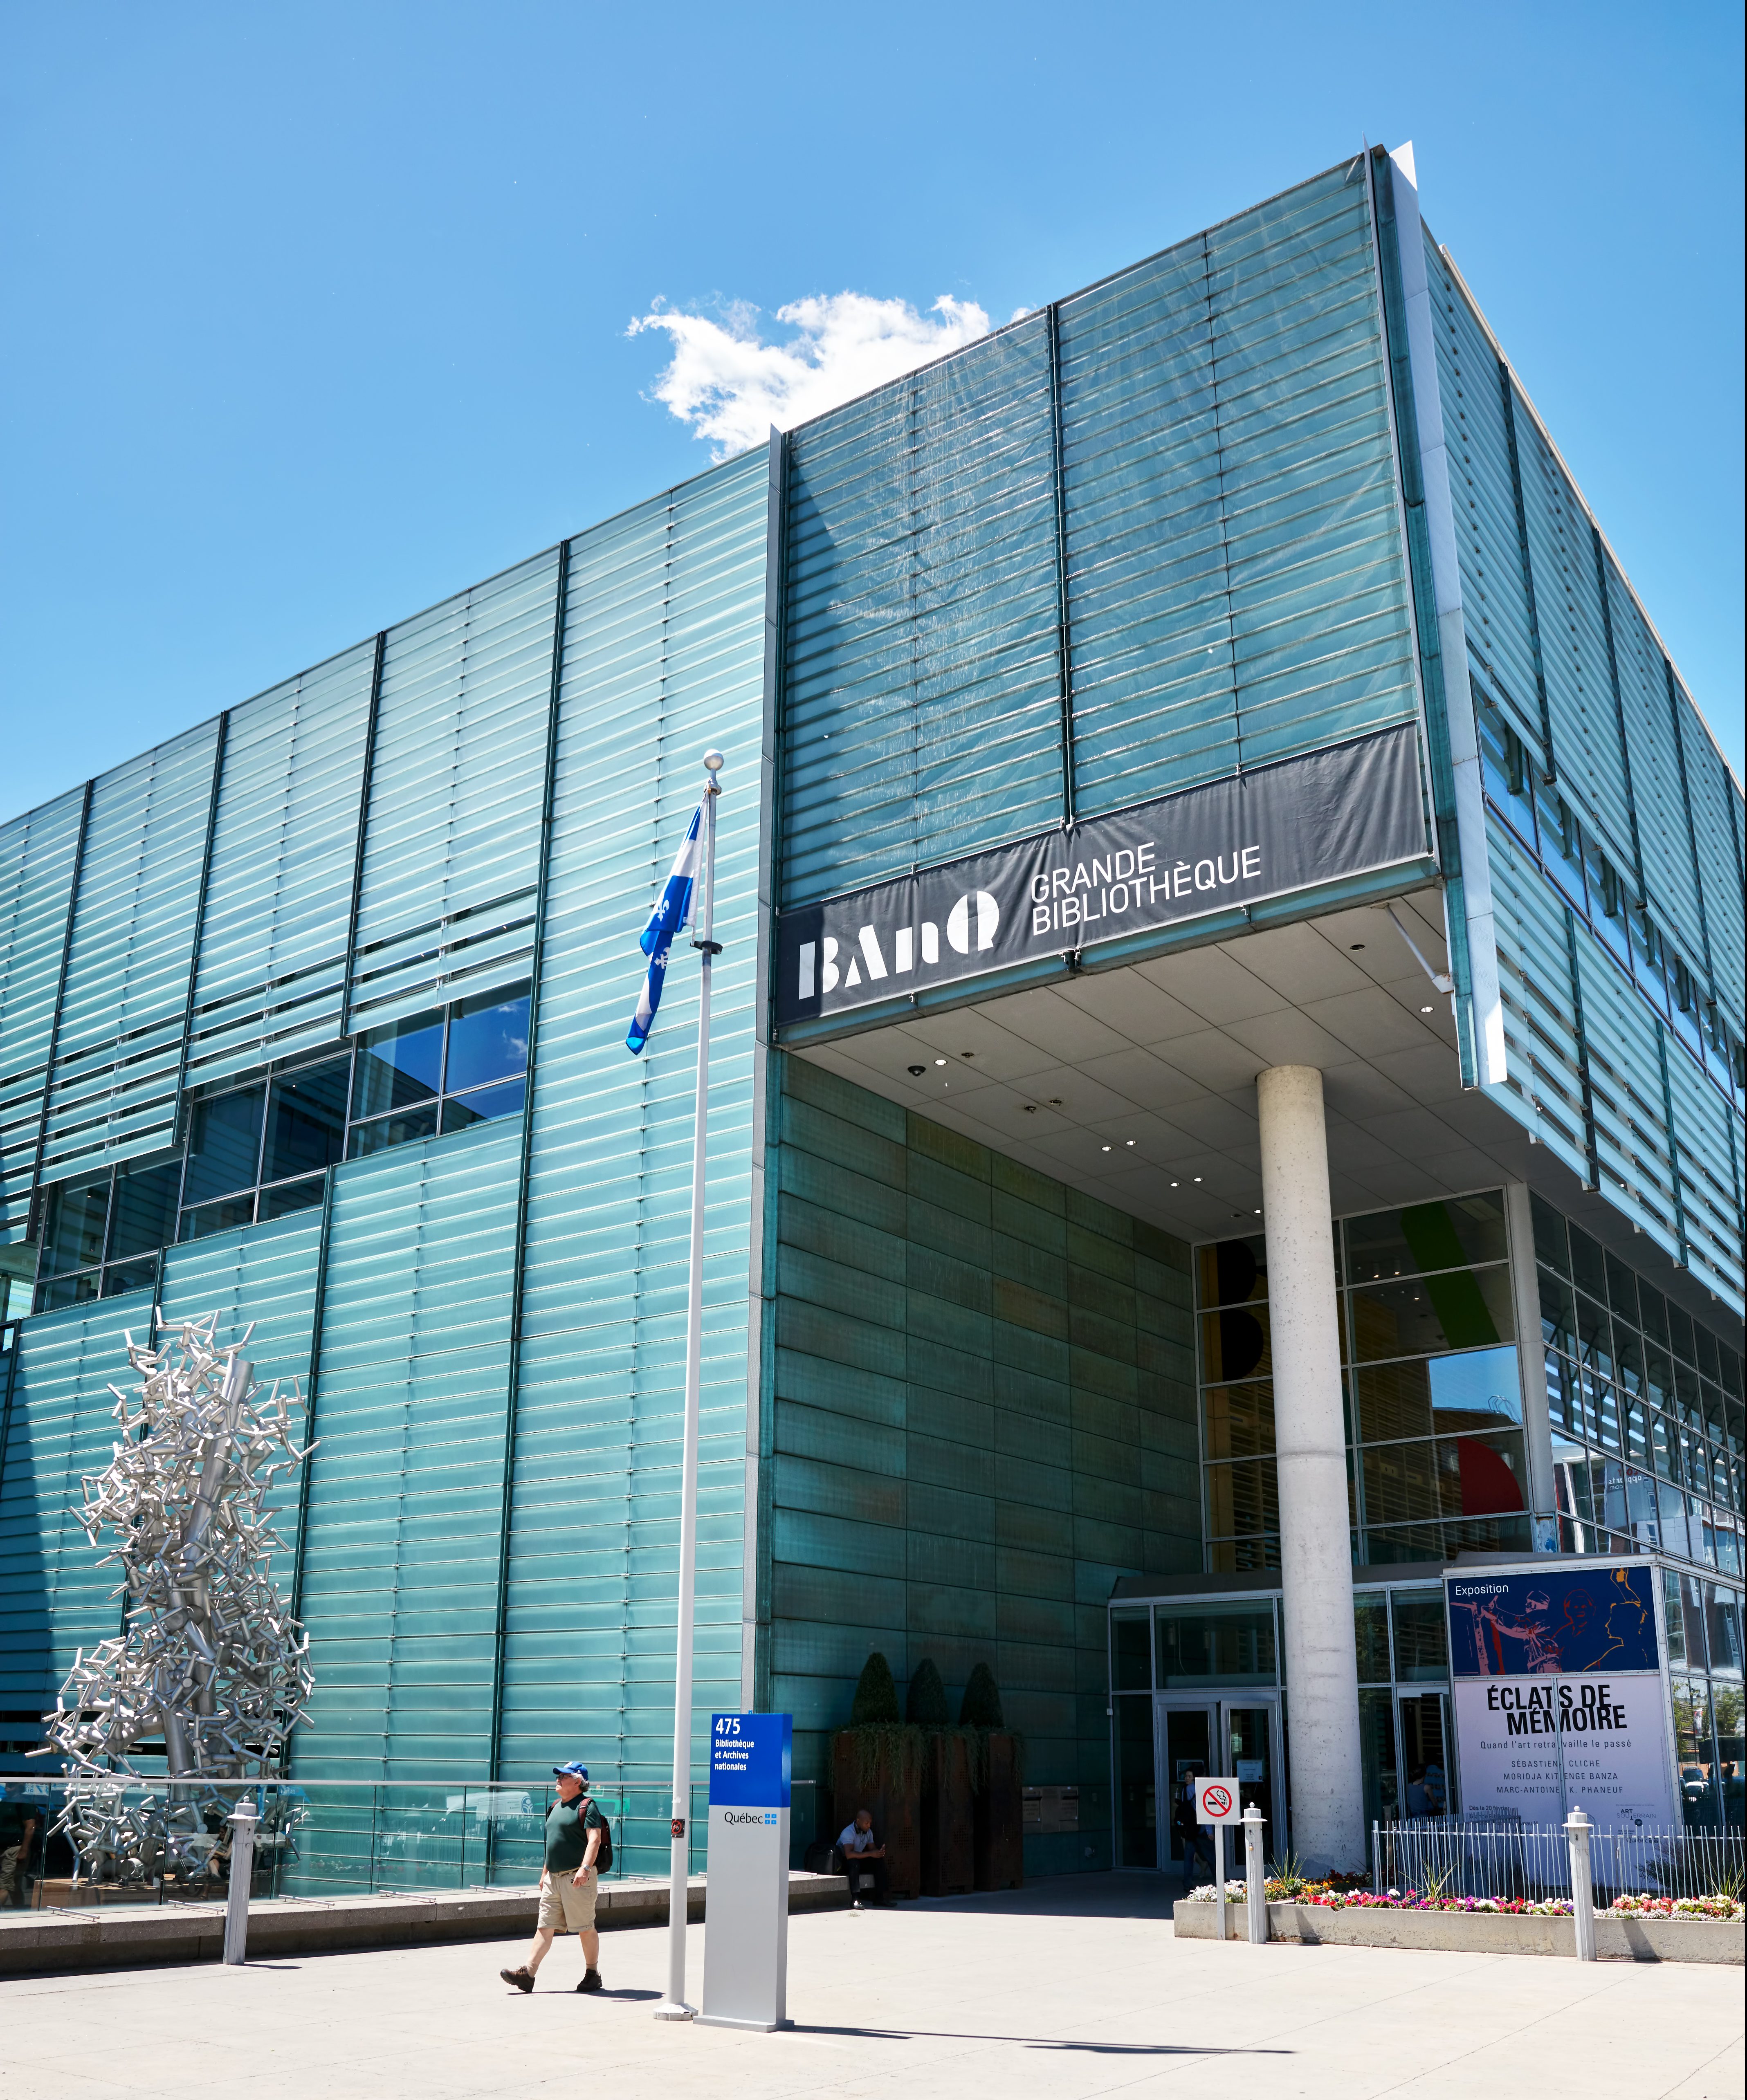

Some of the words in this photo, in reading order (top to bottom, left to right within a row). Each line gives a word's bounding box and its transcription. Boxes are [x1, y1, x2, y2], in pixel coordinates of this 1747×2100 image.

[1031, 841, 1155, 904] GRANDE
[1032, 845, 1261, 936] BIBLIOTHÈQUE
[799, 891, 999, 1000] BAnQ
[1455, 1584, 1509, 1597] Exposition
[1487, 1685, 1573, 1710] ÉCLATS
[1581, 1684, 1612, 1708] DE
[716, 1718, 740, 1734] 475
[1507, 1705, 1627, 1735] MÉMOIRE
[715, 1739, 754, 1749] Bibliothèque
[1480, 1741, 1508, 1749] Quand
[1592, 1739, 1600, 1748] le
[1604, 1739, 1631, 1749] passé
[723, 1751, 749, 1759] Archives
[1511, 1759, 1558, 1768] SÉBASTIEN
[725, 1812, 763, 1825] Québec
